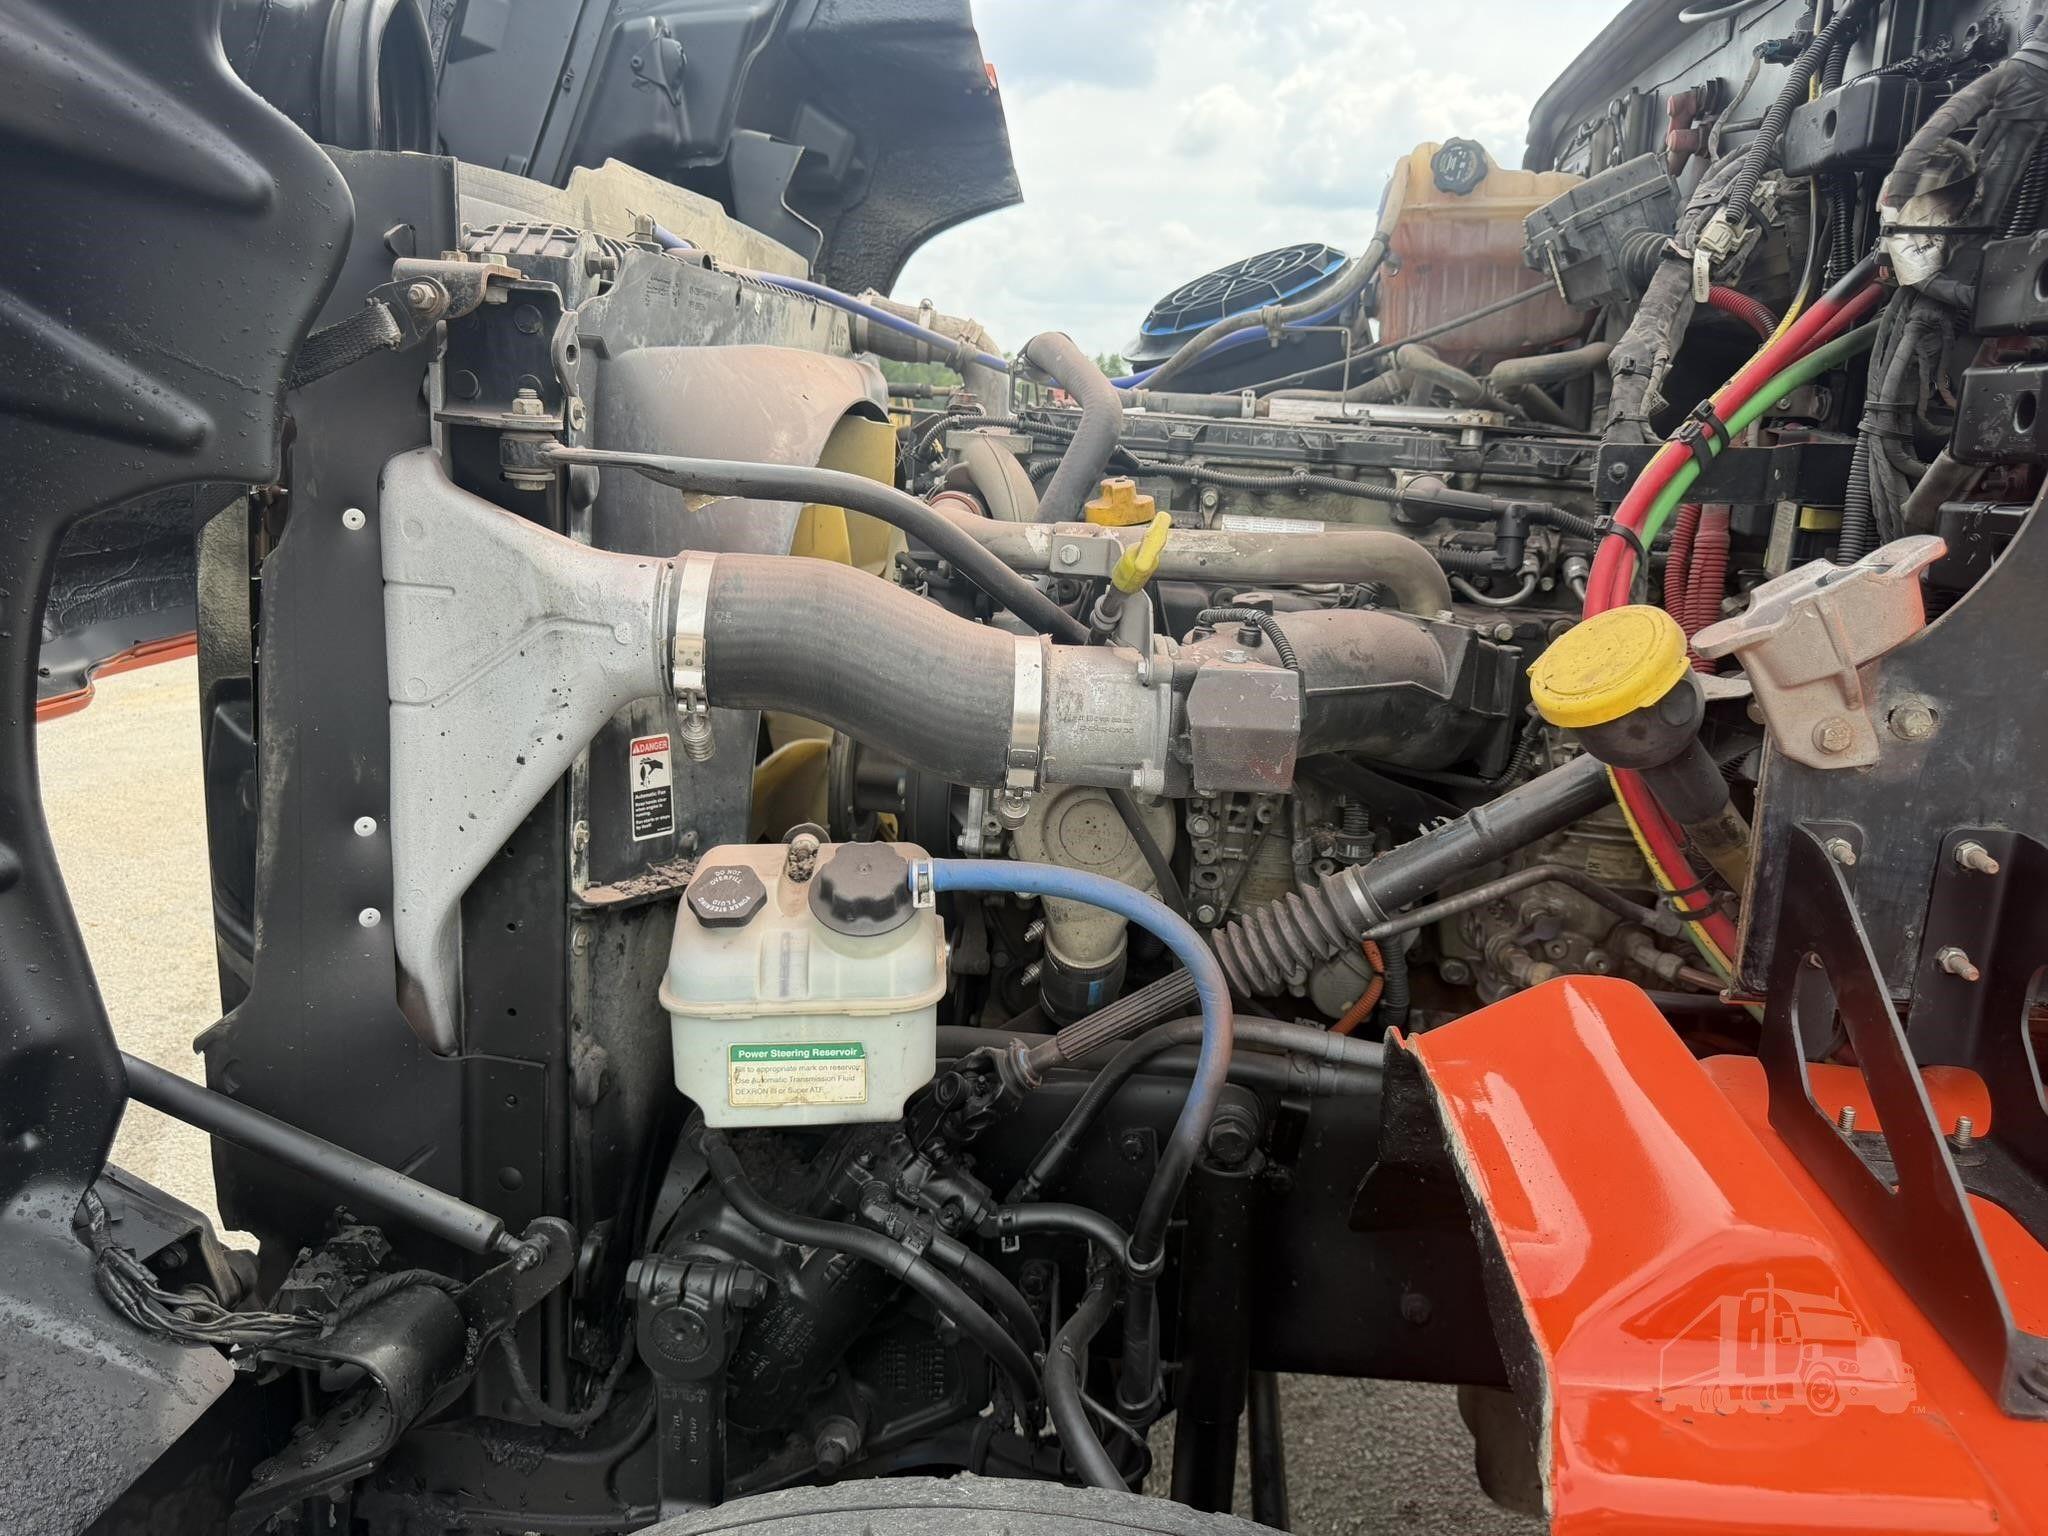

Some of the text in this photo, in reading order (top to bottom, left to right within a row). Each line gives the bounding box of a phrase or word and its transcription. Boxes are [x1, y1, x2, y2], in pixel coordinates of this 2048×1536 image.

[640, 741, 668, 752] DANGER
[710, 875, 743, 885] OVERFILL
[697, 895, 751, 912] POWER STEERING
[712, 898, 737, 906] FLUID
[738, 1048, 858, 1059] Power Steering Reservoir
[755, 1065, 797, 1073] appropriate
[787, 1087, 808, 1095] Super
